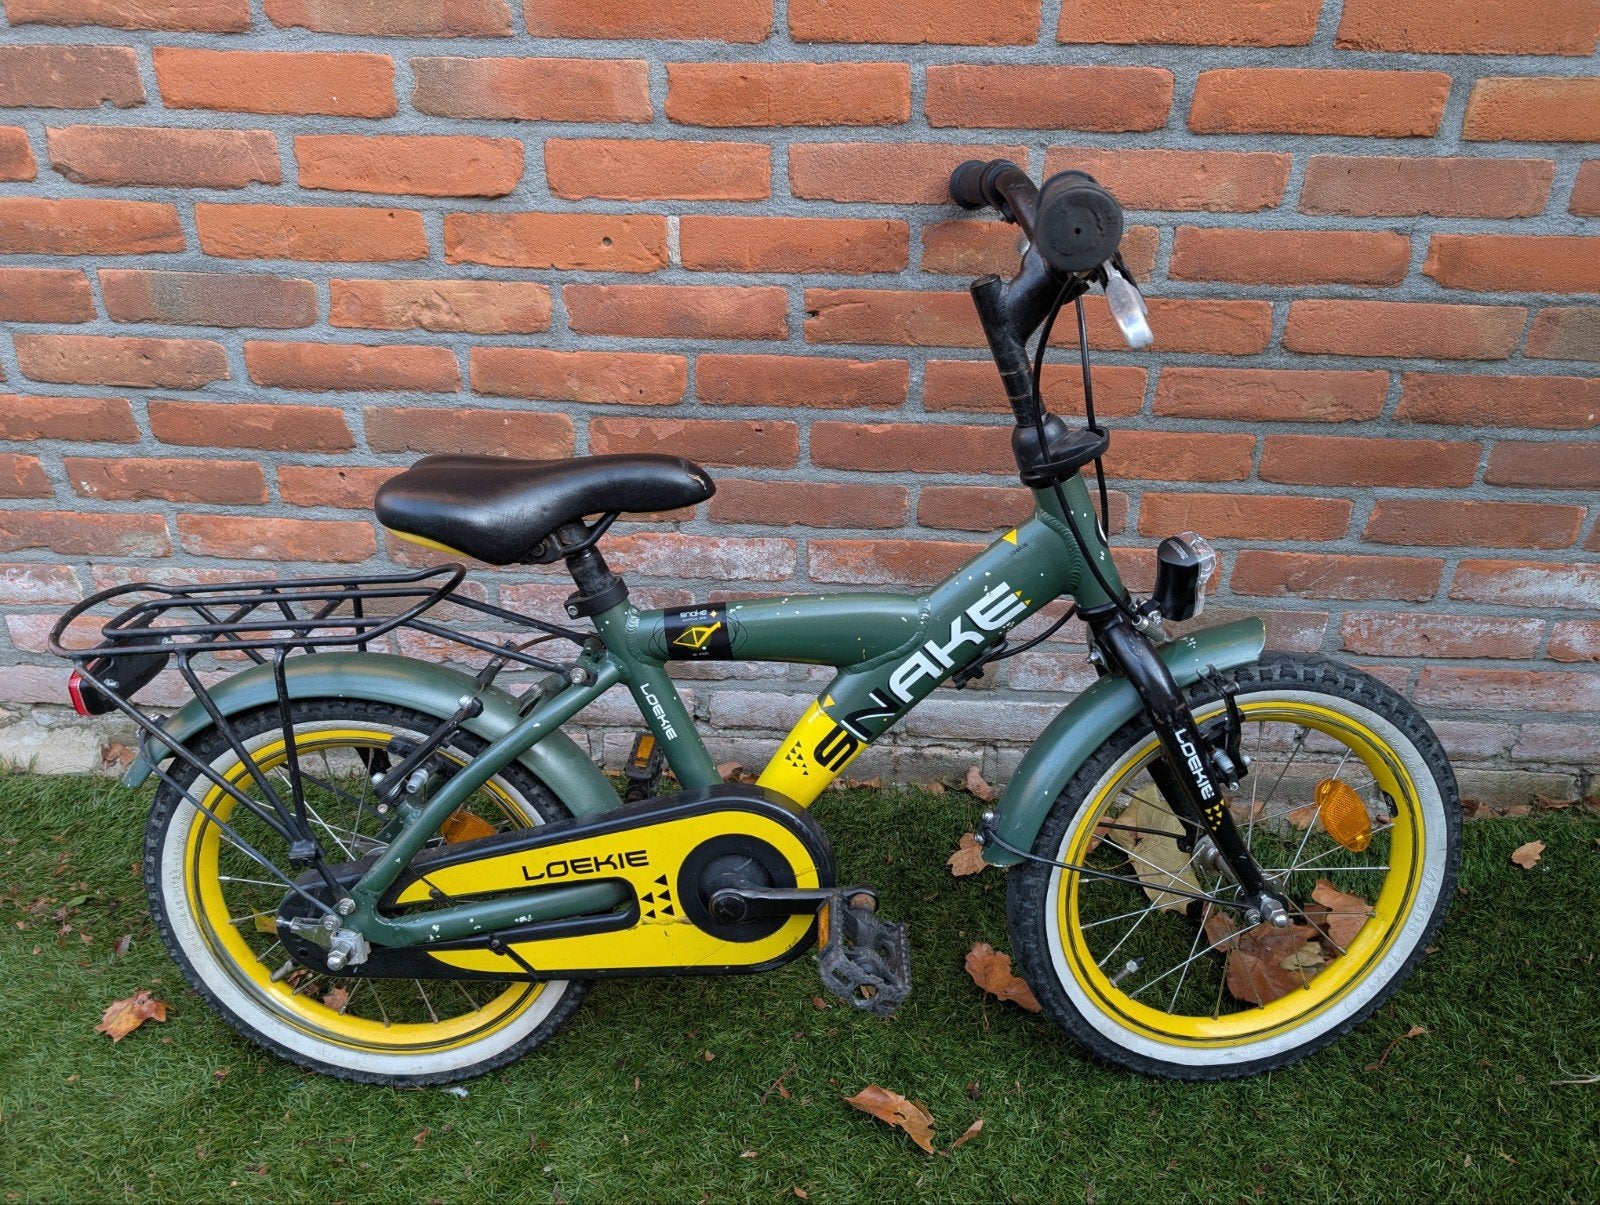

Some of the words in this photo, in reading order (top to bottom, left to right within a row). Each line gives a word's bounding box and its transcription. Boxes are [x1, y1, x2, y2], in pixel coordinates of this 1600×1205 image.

[813, 581, 1029, 773] SNAKE
[640, 682, 678, 741] LOEKIE
[1174, 728, 1216, 801] LOEKIE
[521, 849, 649, 881] LOEKIE
